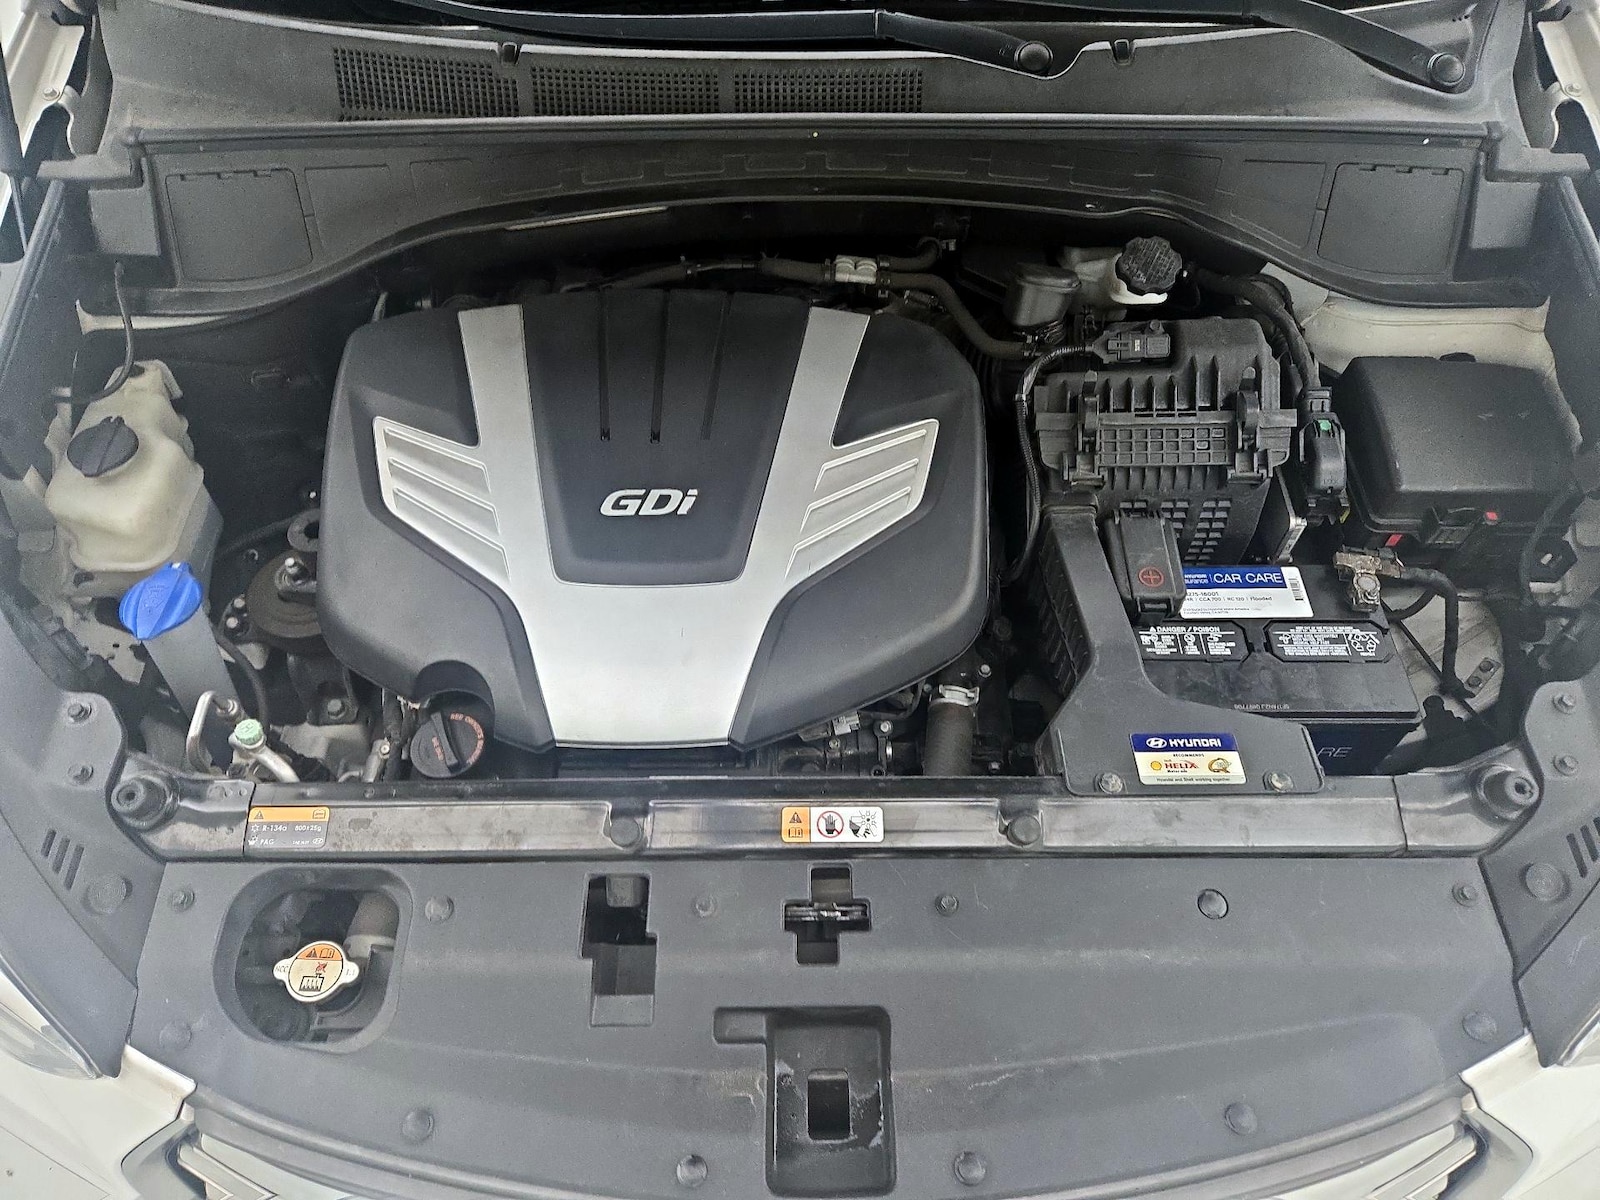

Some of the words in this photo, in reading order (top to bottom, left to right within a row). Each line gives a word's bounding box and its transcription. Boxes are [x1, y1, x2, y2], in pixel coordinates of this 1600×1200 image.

[600, 488, 698, 517] GDi
[1213, 573, 1242, 583] CAR
[1245, 573, 1284, 583] CARE
[1169, 738, 1222, 748] HYUNDAI
